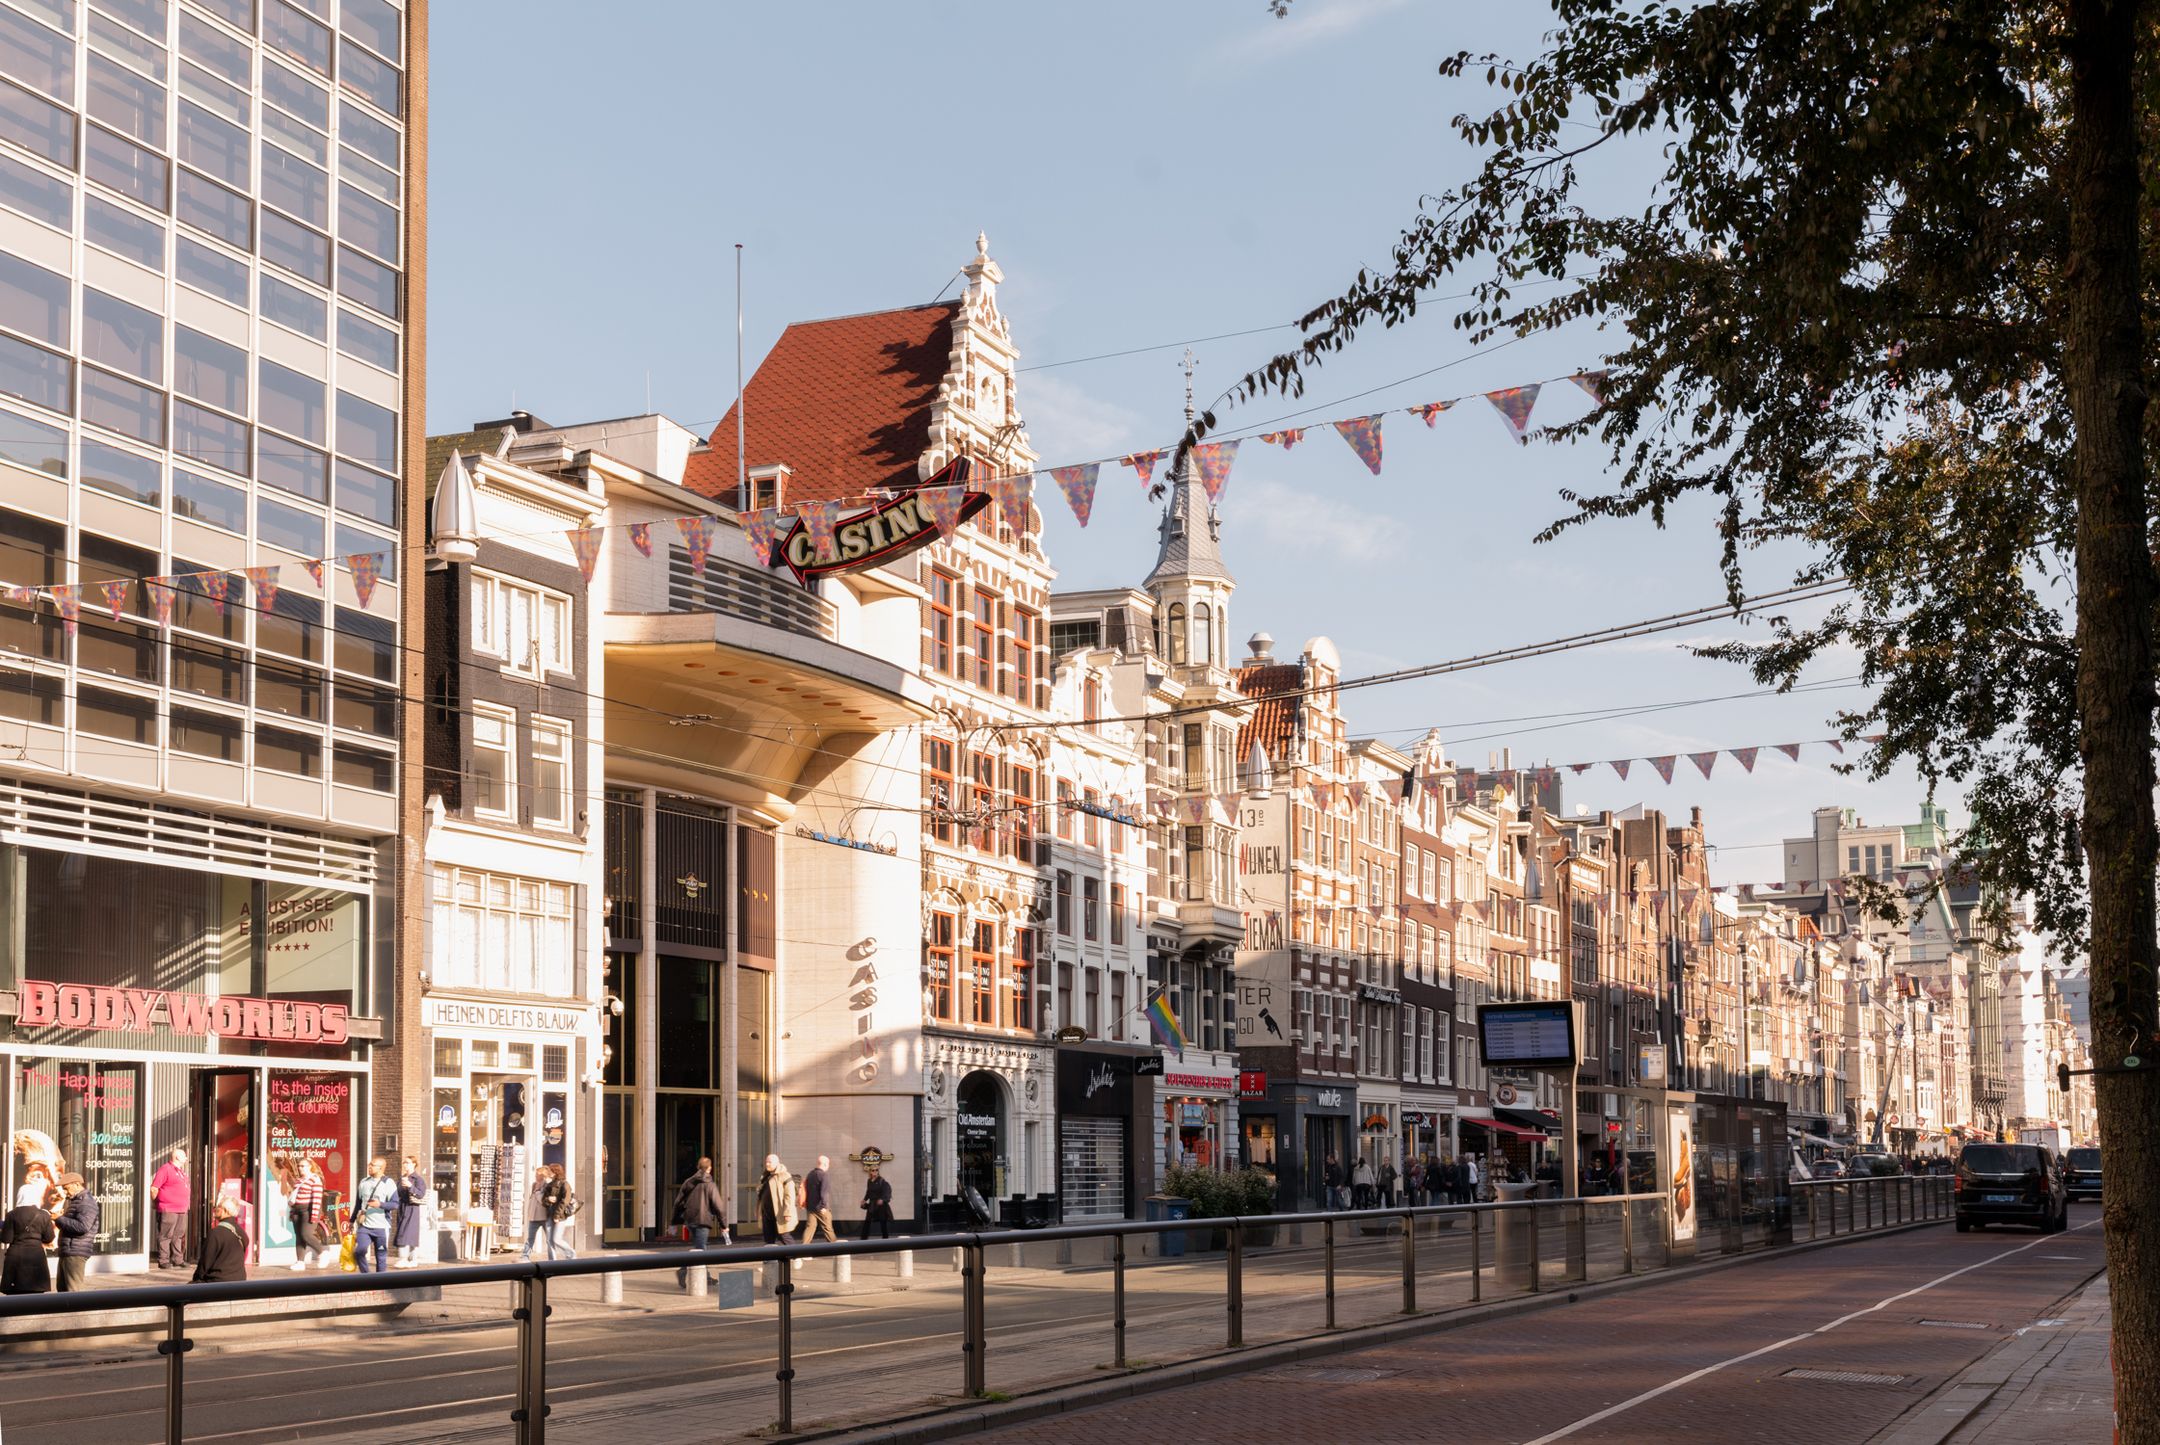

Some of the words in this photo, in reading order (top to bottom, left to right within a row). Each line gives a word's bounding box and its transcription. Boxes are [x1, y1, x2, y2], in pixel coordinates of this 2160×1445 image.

[240, 902, 250, 916] A
[266, 897, 335, 915] UST-SEE
[240, 918, 334, 936] EIBITION!
[15, 980, 158, 1033] BODY
[164, 992, 349, 1044] WORLDS
[438, 1004, 485, 1023] HEINEN
[489, 1008, 533, 1028] DELFTS
[23, 1069, 52, 1087] The
[57, 1071, 133, 1092] Happiness
[272, 1080, 289, 1095] It's
[292, 1081, 311, 1095] the
[314, 1082, 348, 1097] inside
[83, 1092, 133, 1113] Project
[271, 1098, 295, 1113] that
[298, 1100, 339, 1114] counts
[112, 1122, 133, 1133] Over
[271, 1127, 286, 1137] Get
[91, 1131, 112, 1145] 200
[112, 1134, 133, 1146] REAL
[271, 1138, 292, 1148] FREE
[293, 1137, 337, 1149] BODYSCAN
[103, 1146, 132, 1157] human
[271, 1149, 288, 1158] with
[289, 1150, 305, 1159] your
[306, 1149, 326, 1158] ticket
[86, 1158, 133, 1170] specimens
[105, 1181, 132, 1192] 7-floor
